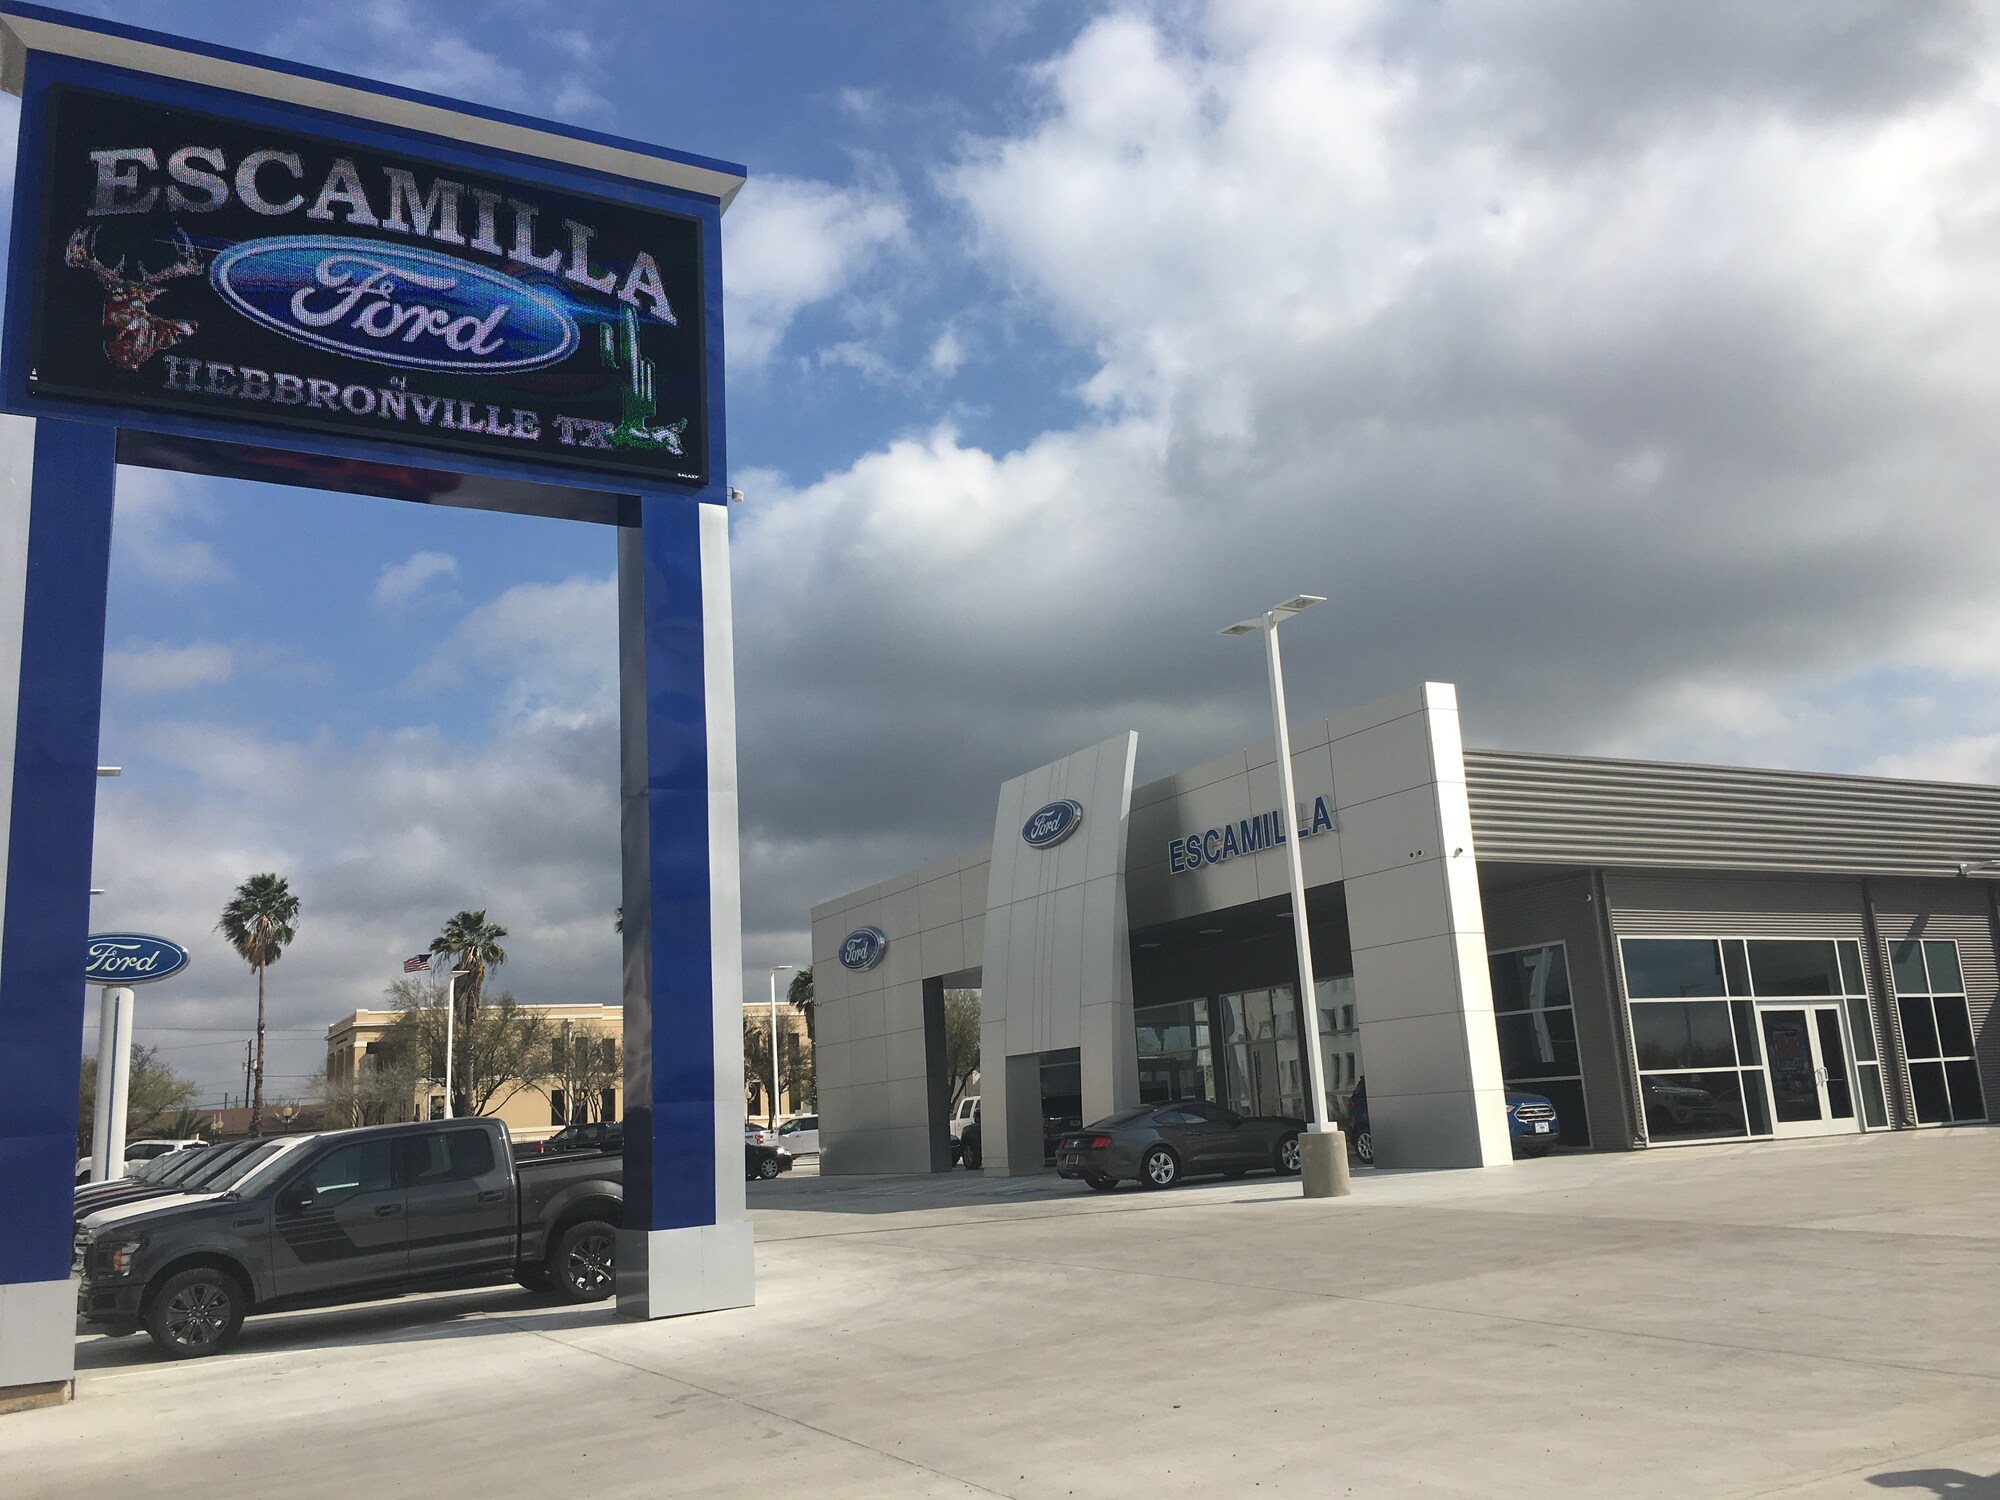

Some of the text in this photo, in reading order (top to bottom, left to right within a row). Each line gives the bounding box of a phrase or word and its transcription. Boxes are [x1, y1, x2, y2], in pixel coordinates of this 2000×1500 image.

[87, 146, 678, 326] ESCAMILLA
[291, 254, 509, 355] Ford
[162, 354, 542, 441] HEBBRONVILLE
[1030, 810, 1062, 839] Ford
[86, 942, 160, 972] Ford
[845, 938, 869, 963] Ford
